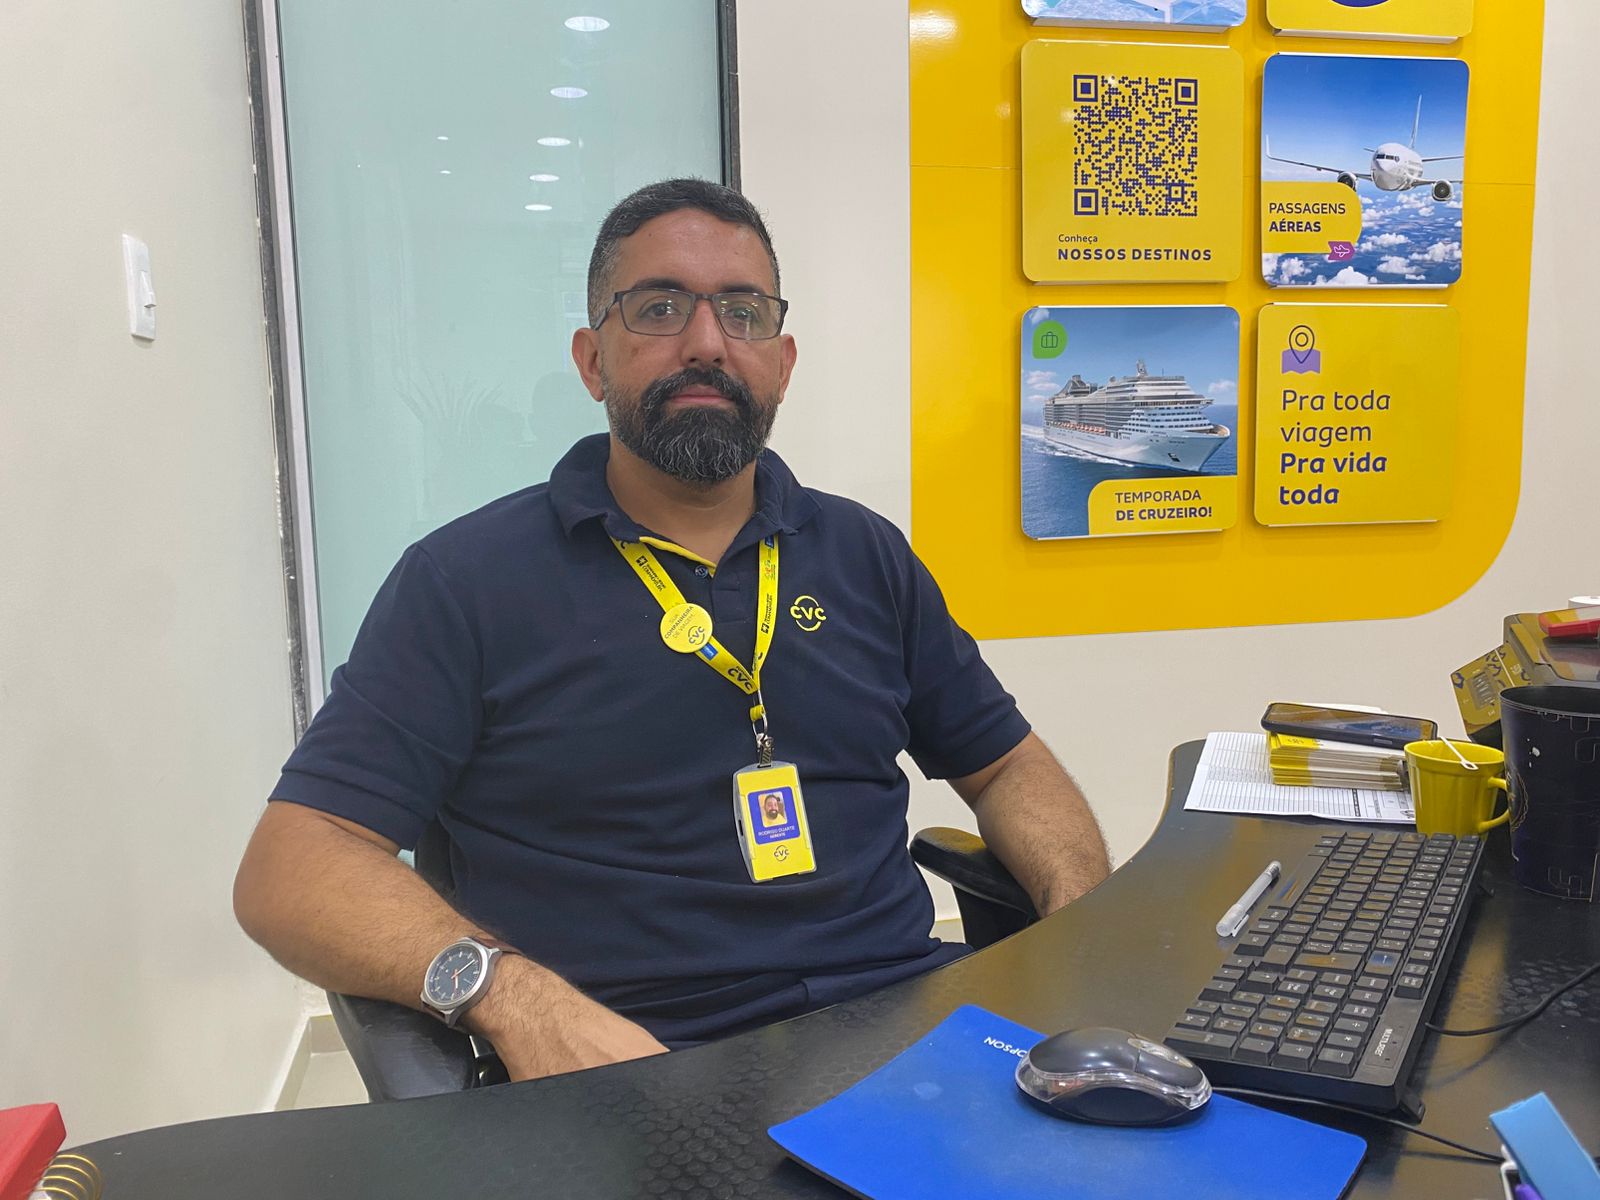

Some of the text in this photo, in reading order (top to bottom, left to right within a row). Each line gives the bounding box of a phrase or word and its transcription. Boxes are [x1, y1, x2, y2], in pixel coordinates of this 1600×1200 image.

[1269, 201, 1346, 215] PASSAGENS
[1269, 218, 1322, 233] AÉREAS
[1058, 233, 1098, 245] Conheça
[1058, 248, 1212, 262] NOSSOS DESTINOS
[1282, 389, 1391, 411] Pra toda
[1280, 421, 1371, 448] viagem
[1280, 451, 1388, 474] Pra vida
[1115, 489, 1202, 503] TEMPORADA
[1279, 483, 1340, 505] toda
[1116, 507, 1212, 521] DE CRUZEIRO!
[688, 626, 705, 645] CVC
[983, 1036, 1028, 1058] OPSON
